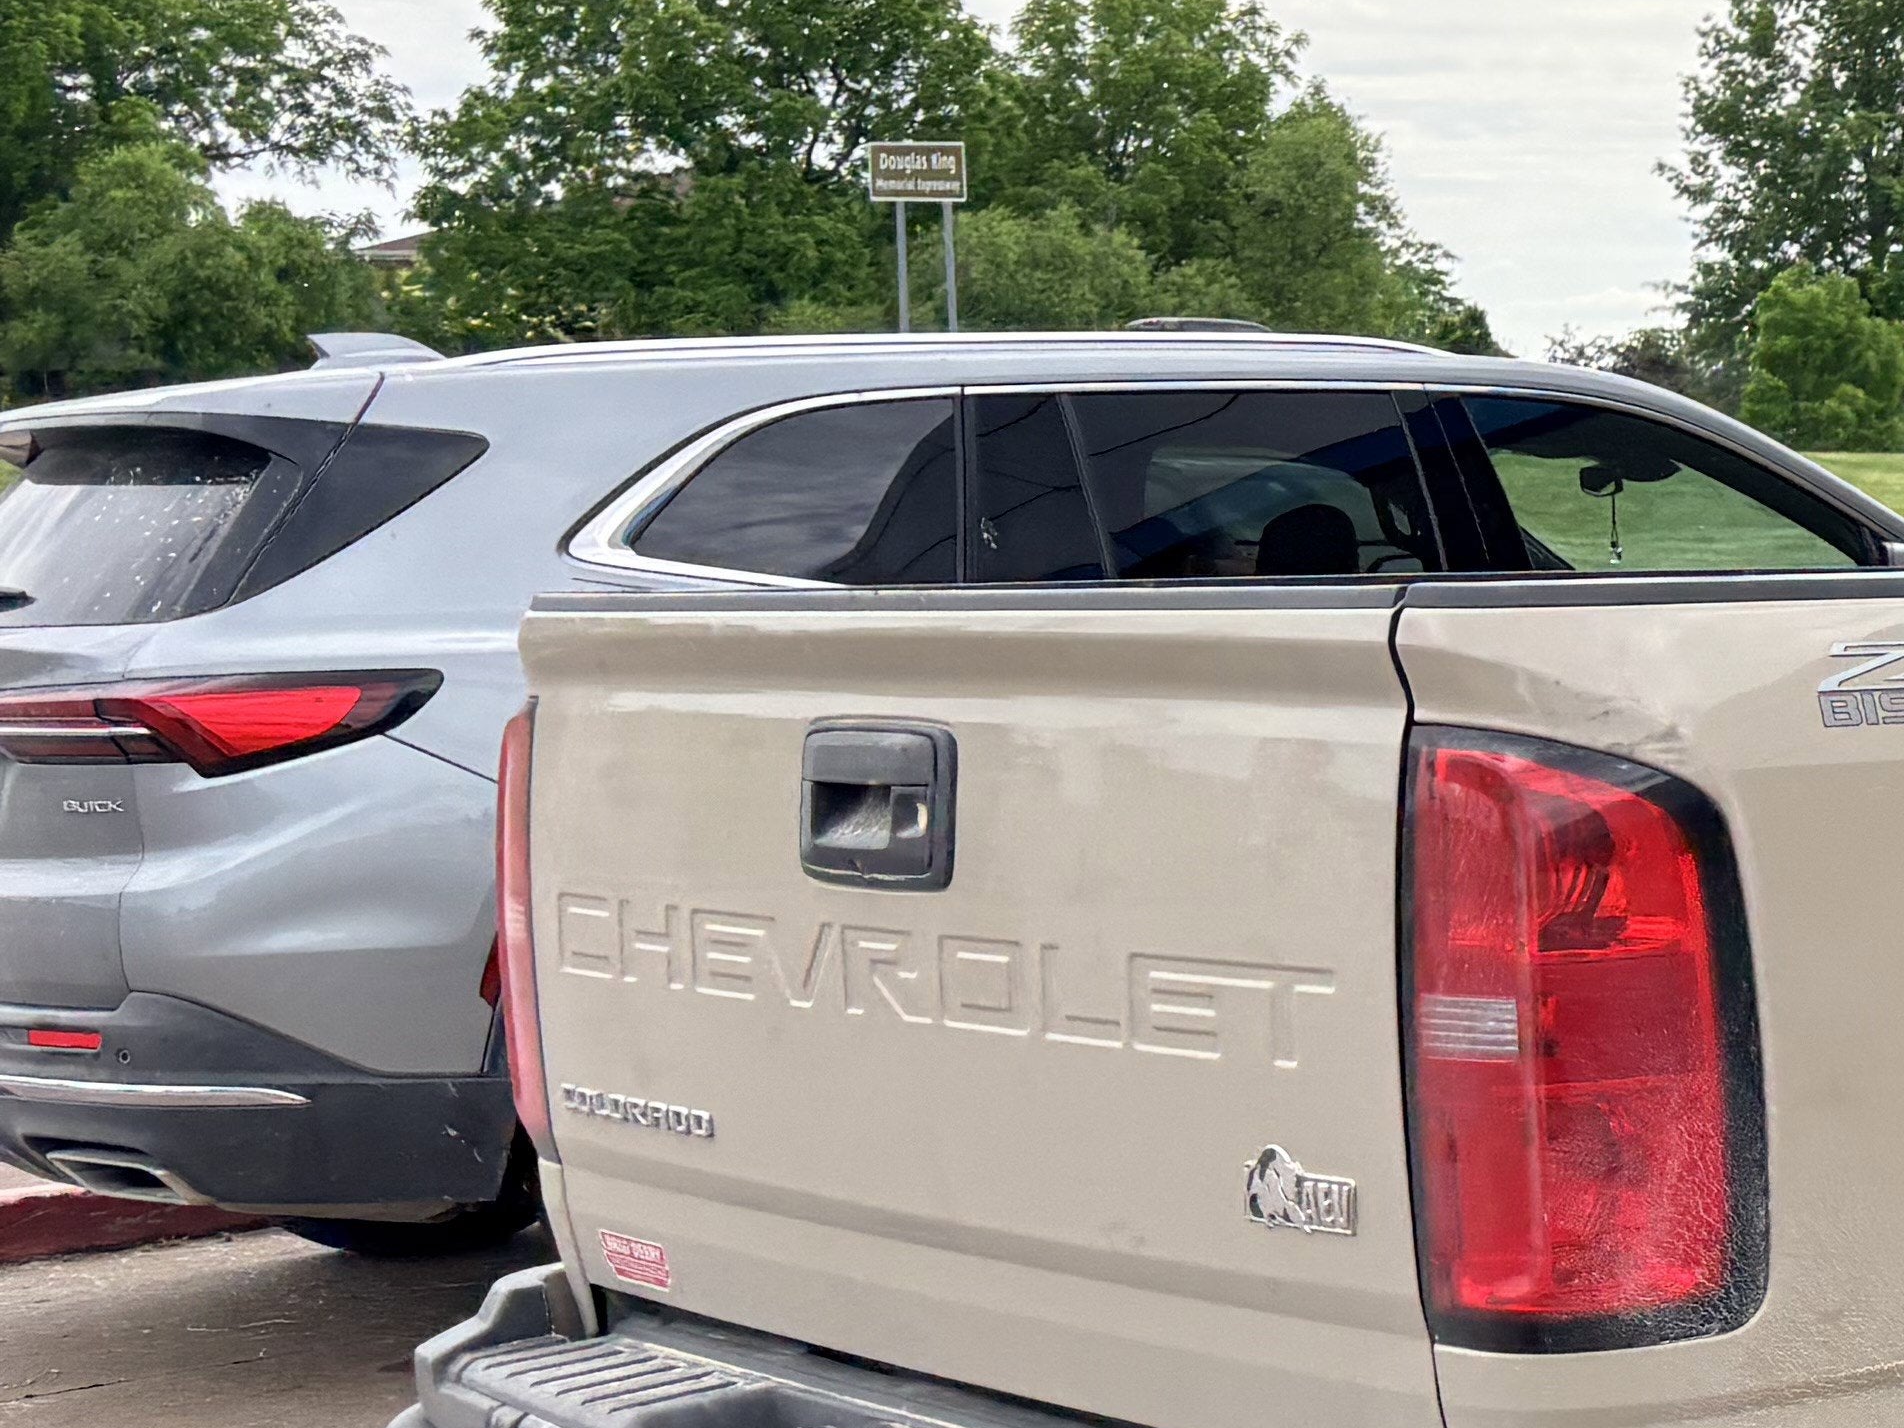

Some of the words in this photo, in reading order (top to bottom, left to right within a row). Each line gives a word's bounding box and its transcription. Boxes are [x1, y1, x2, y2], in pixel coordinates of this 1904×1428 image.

[879, 152, 928, 174] Douglas
[930, 152, 956, 174] King
[62, 799, 125, 813] BUICK
[557, 892, 1337, 1068] CHEVROLET
[560, 1083, 715, 1138] COLORADO
